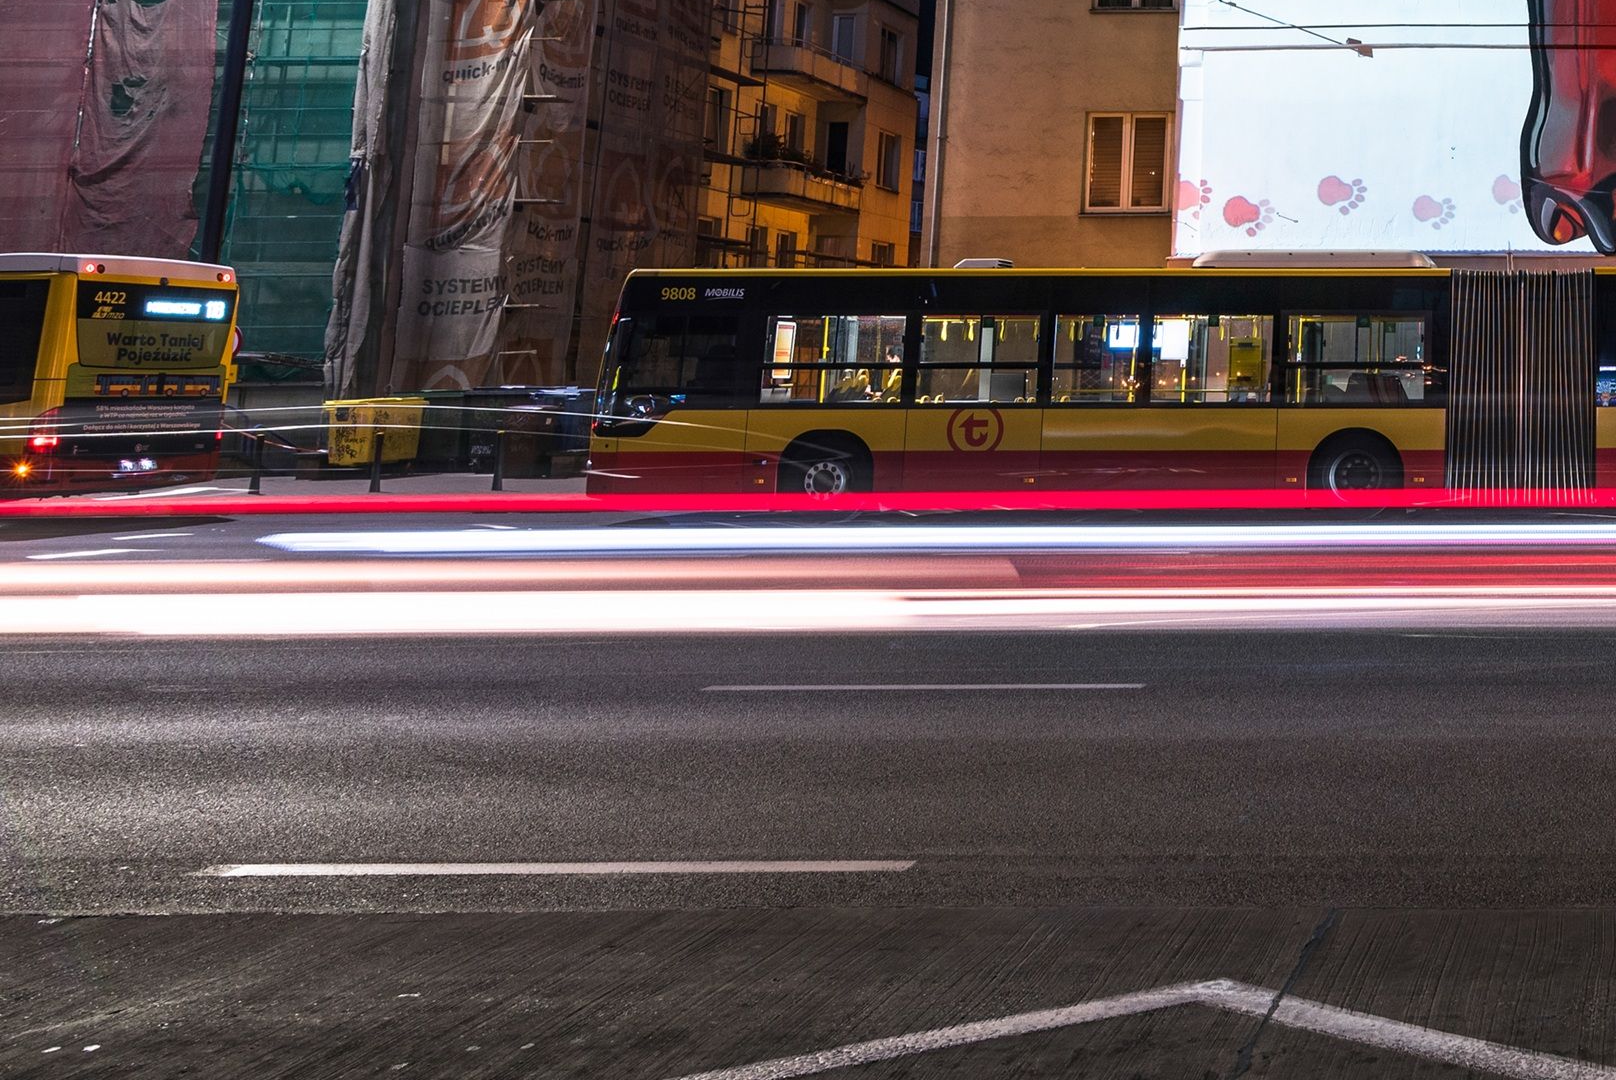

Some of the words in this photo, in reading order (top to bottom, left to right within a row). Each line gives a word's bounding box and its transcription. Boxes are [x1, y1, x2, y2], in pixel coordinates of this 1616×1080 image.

[422, 275, 508, 295] SYSTEMY
[661, 287, 697, 300] 9808
[704, 288, 745, 297] MOBILIS
[94, 291, 127, 305] 4422
[106, 332, 156, 348] Warto
[160, 333, 205, 352] Taniej
